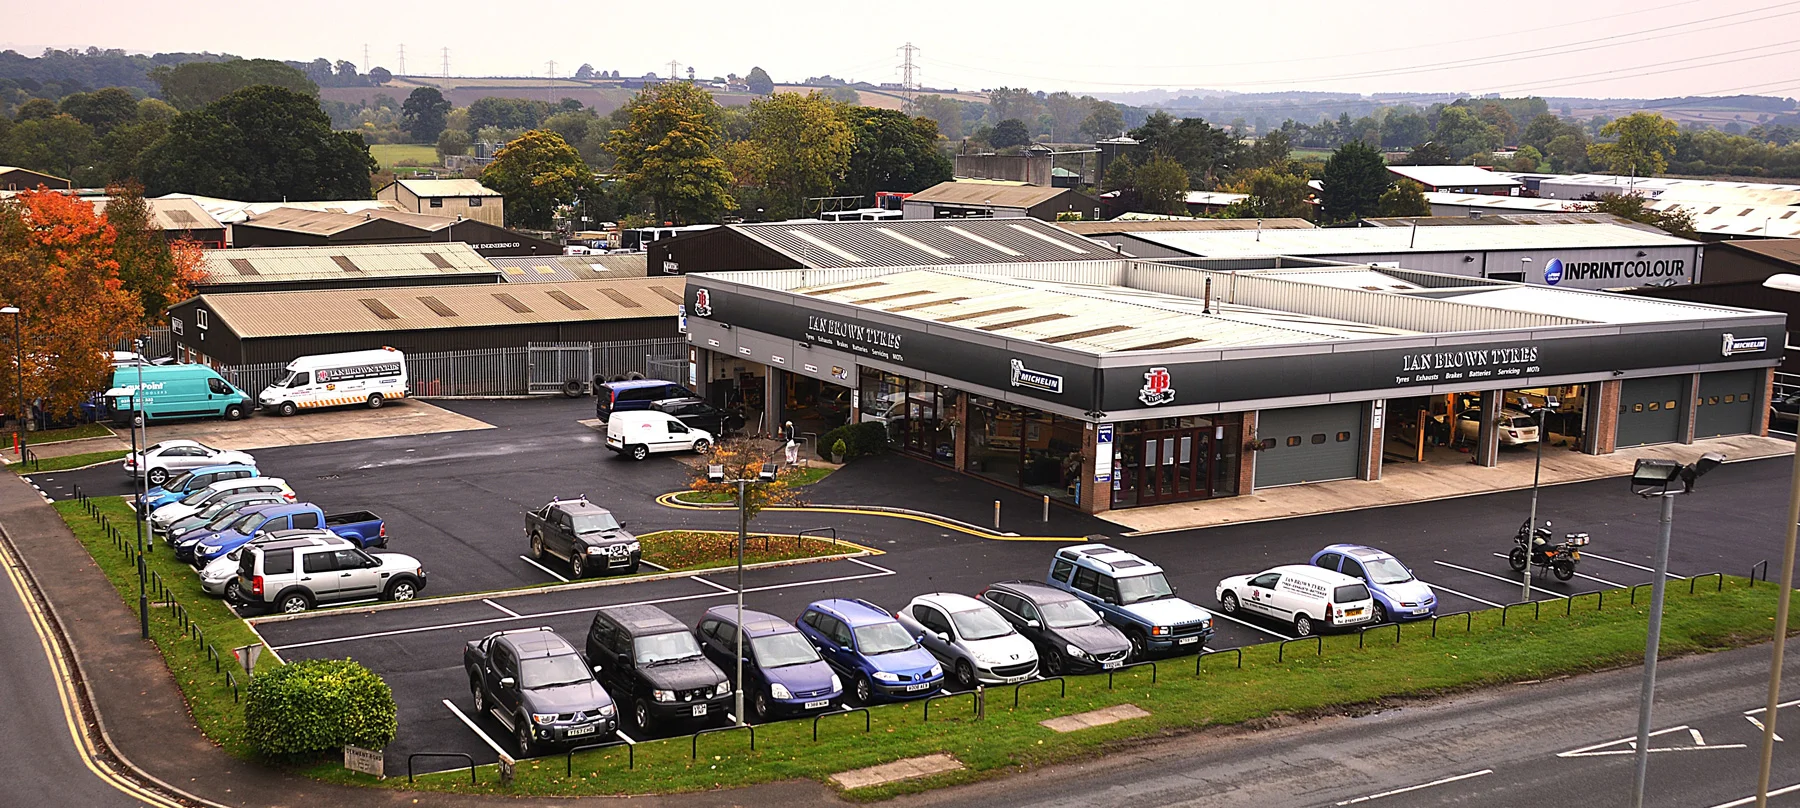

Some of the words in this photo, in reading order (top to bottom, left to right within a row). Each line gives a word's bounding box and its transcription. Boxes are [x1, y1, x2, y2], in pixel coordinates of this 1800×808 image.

[1564, 261, 1623, 280] INPRINT
[1623, 259, 1684, 278] COLOUR
[808, 315, 828, 333] IAN
[828, 319, 865, 341] BROWN
[866, 327, 902, 350] TYRES
[805, 332, 815, 341] Tyres
[817, 335, 833, 345] Exhausts
[836, 340, 849, 349] Brakes
[852, 344, 868, 353] Batteries
[871, 348, 889, 360] Servicing
[1733, 340, 1765, 349] MICHELIN
[1403, 353, 1432, 371] IAN
[1434, 349, 1489, 369] BROWN
[1491, 346, 1539, 365] TYRES
[1020, 372, 1058, 388] MICHELIN
[1395, 376, 1410, 385] Tyres
[1415, 373, 1439, 382] Exhausts
[1445, 371, 1463, 380] Brakes
[1468, 369, 1492, 378] Batteries
[1497, 367, 1521, 376] Servicing
